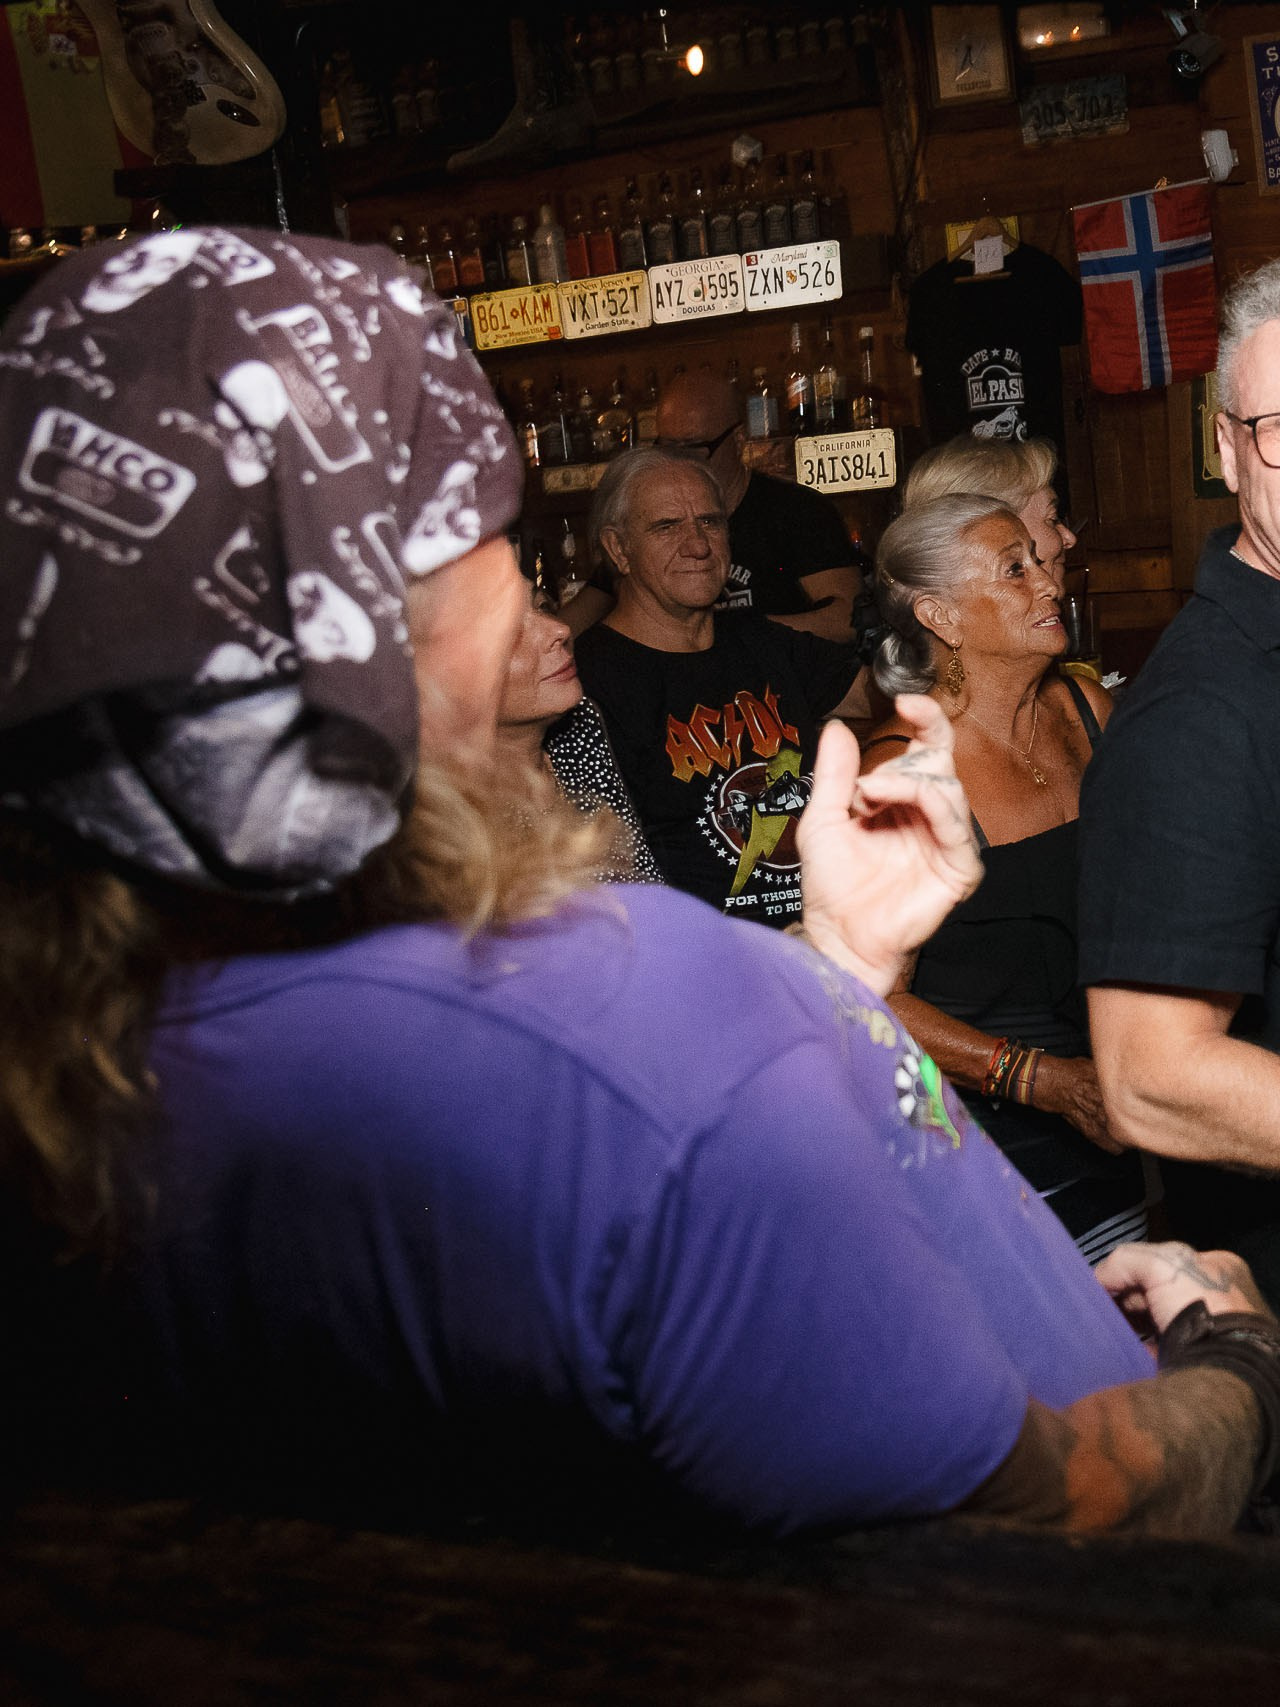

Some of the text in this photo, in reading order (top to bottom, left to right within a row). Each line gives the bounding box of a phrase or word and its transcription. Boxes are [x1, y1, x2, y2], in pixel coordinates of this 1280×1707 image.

[771, 249, 808, 264] Maryland
[670, 261, 721, 278] GEORGIA
[748, 260, 835, 297] ZXN 526
[578, 278, 625, 291] New Jersey
[656, 271, 739, 309] AYZ 1595
[476, 293, 554, 334] 861 KAM
[566, 286, 640, 322] VXT 52T
[682, 303, 716, 315] DOUGLAS
[585, 318, 629, 331] Garden State
[1004, 348, 1021, 368] BA
[971, 381, 988, 403] EL
[820, 439, 871, 452] CALIFORNIA
[804, 451, 890, 485] 3AIS841
[725, 888, 802, 907] FOR THOSE
[766, 905, 783, 915] TO
